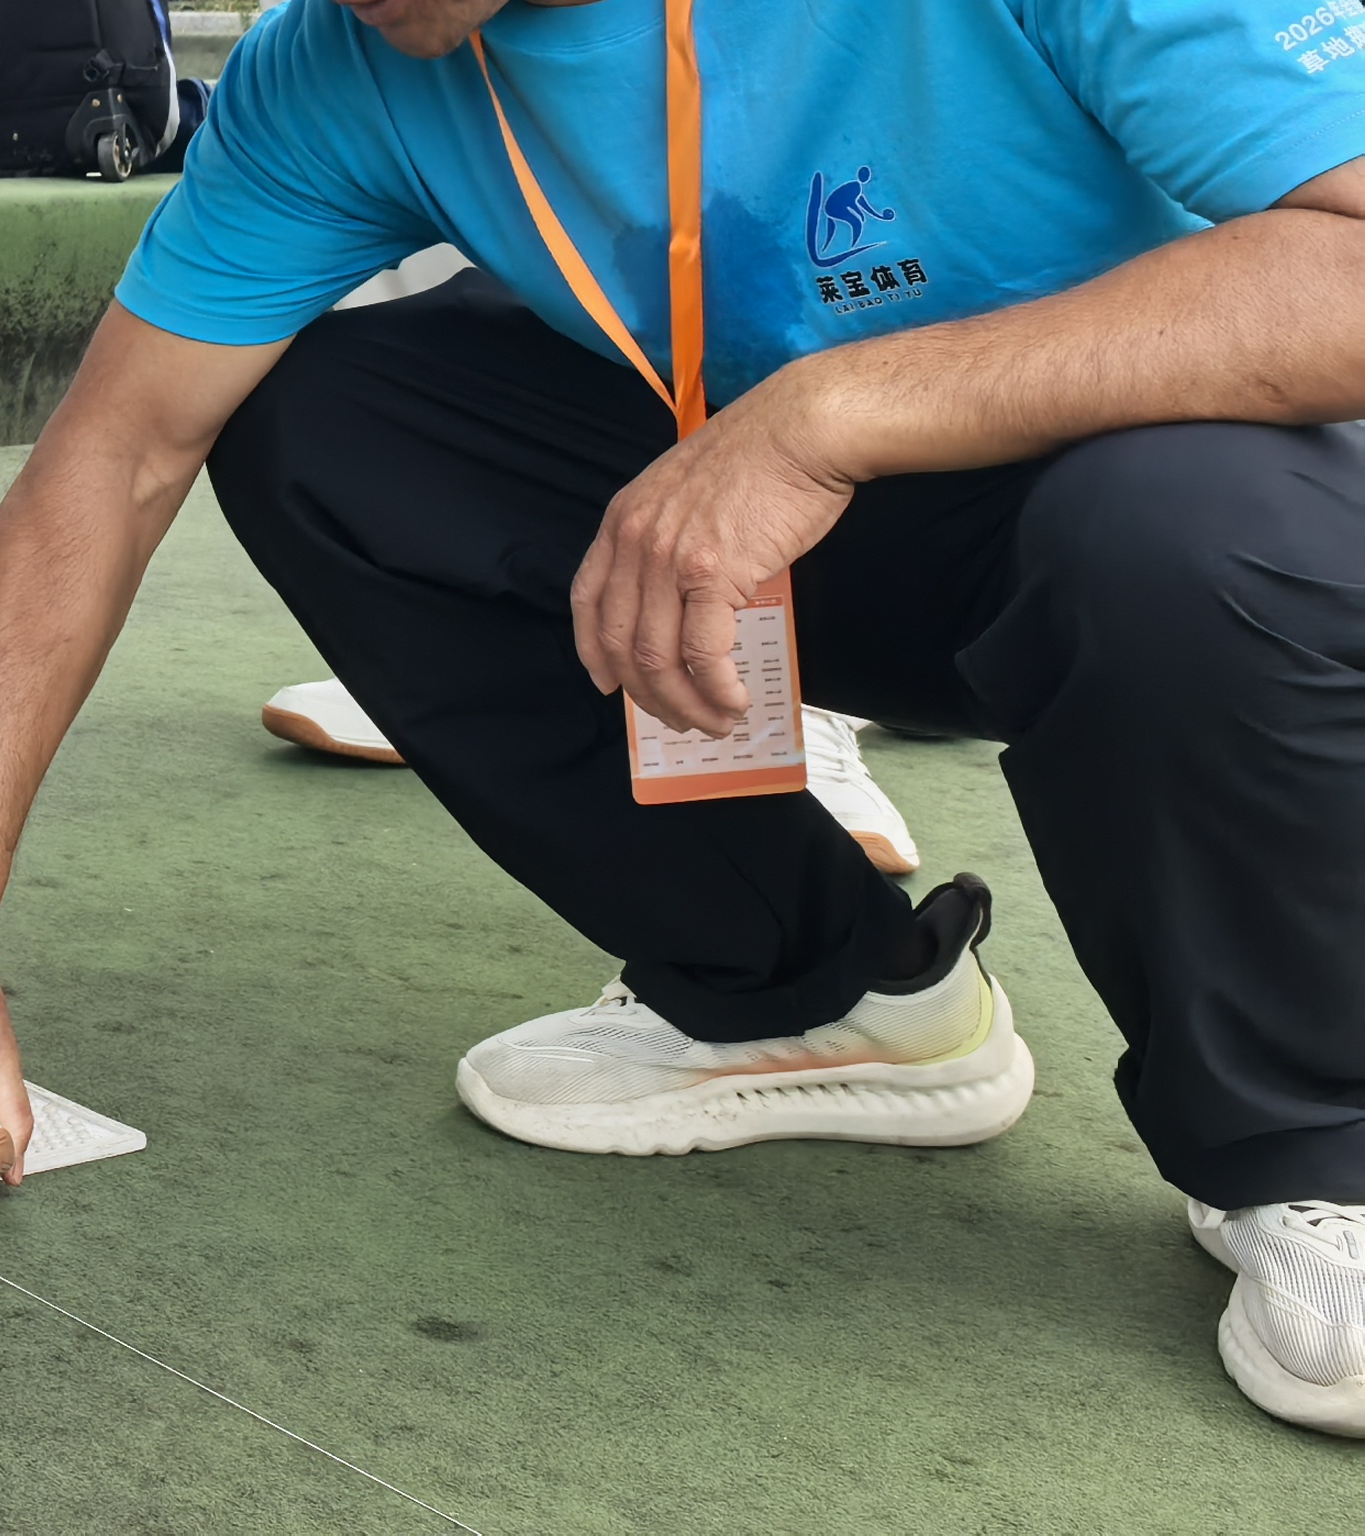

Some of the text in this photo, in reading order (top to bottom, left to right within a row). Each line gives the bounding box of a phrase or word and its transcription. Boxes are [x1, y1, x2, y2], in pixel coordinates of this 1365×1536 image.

[816, 259, 927, 303] 莱宝体育
[834, 303, 855, 314] LAI
[857, 297, 883, 309] BAO
